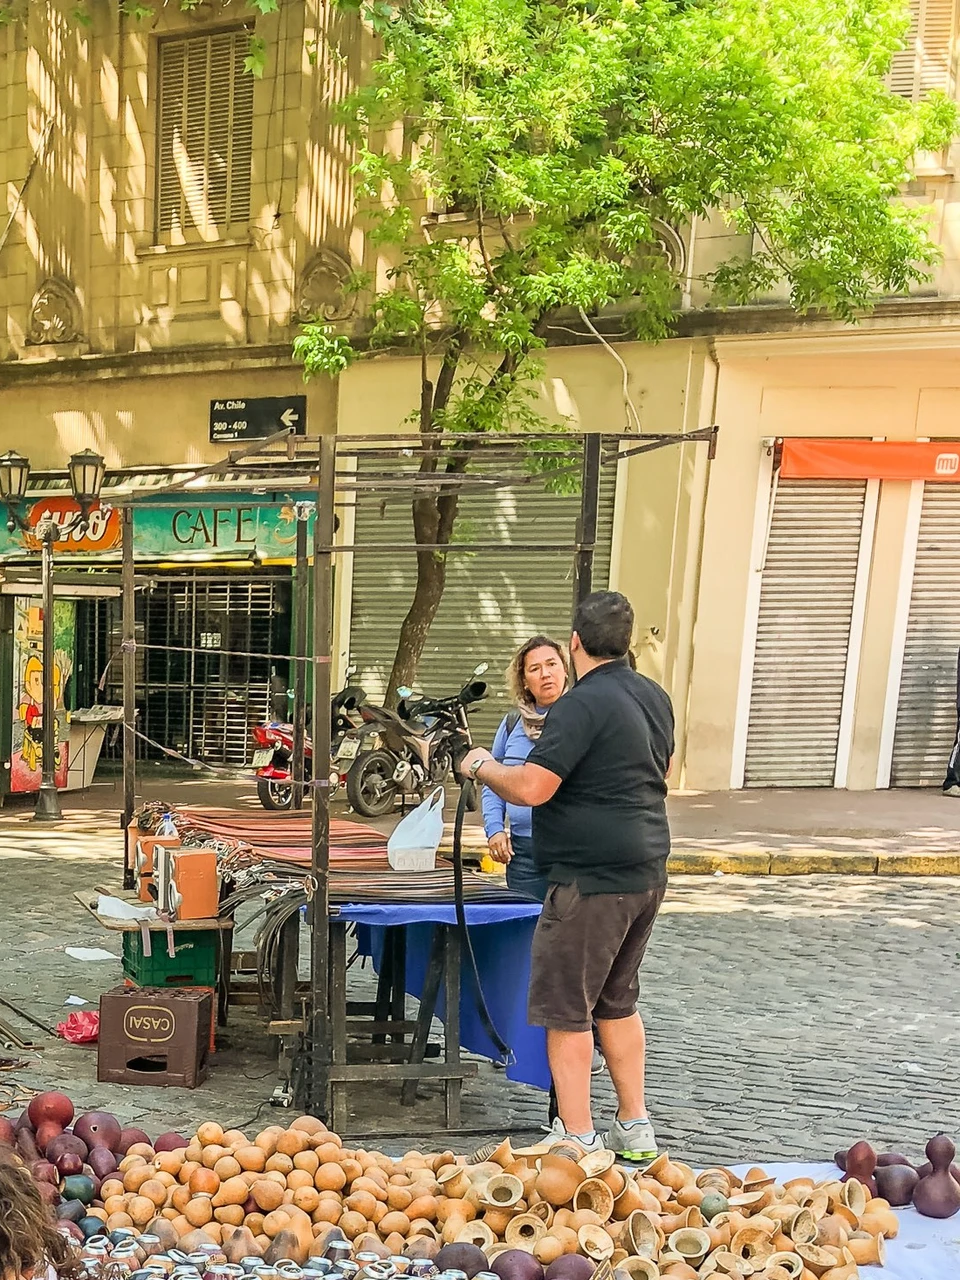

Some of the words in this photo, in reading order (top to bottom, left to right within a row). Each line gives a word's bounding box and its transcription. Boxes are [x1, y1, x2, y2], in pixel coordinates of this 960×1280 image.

[214, 402, 225, 410] Av.
[226, 401, 246, 410] Chile
[213, 422, 227, 430] 300
[233, 421, 247, 430] 400
